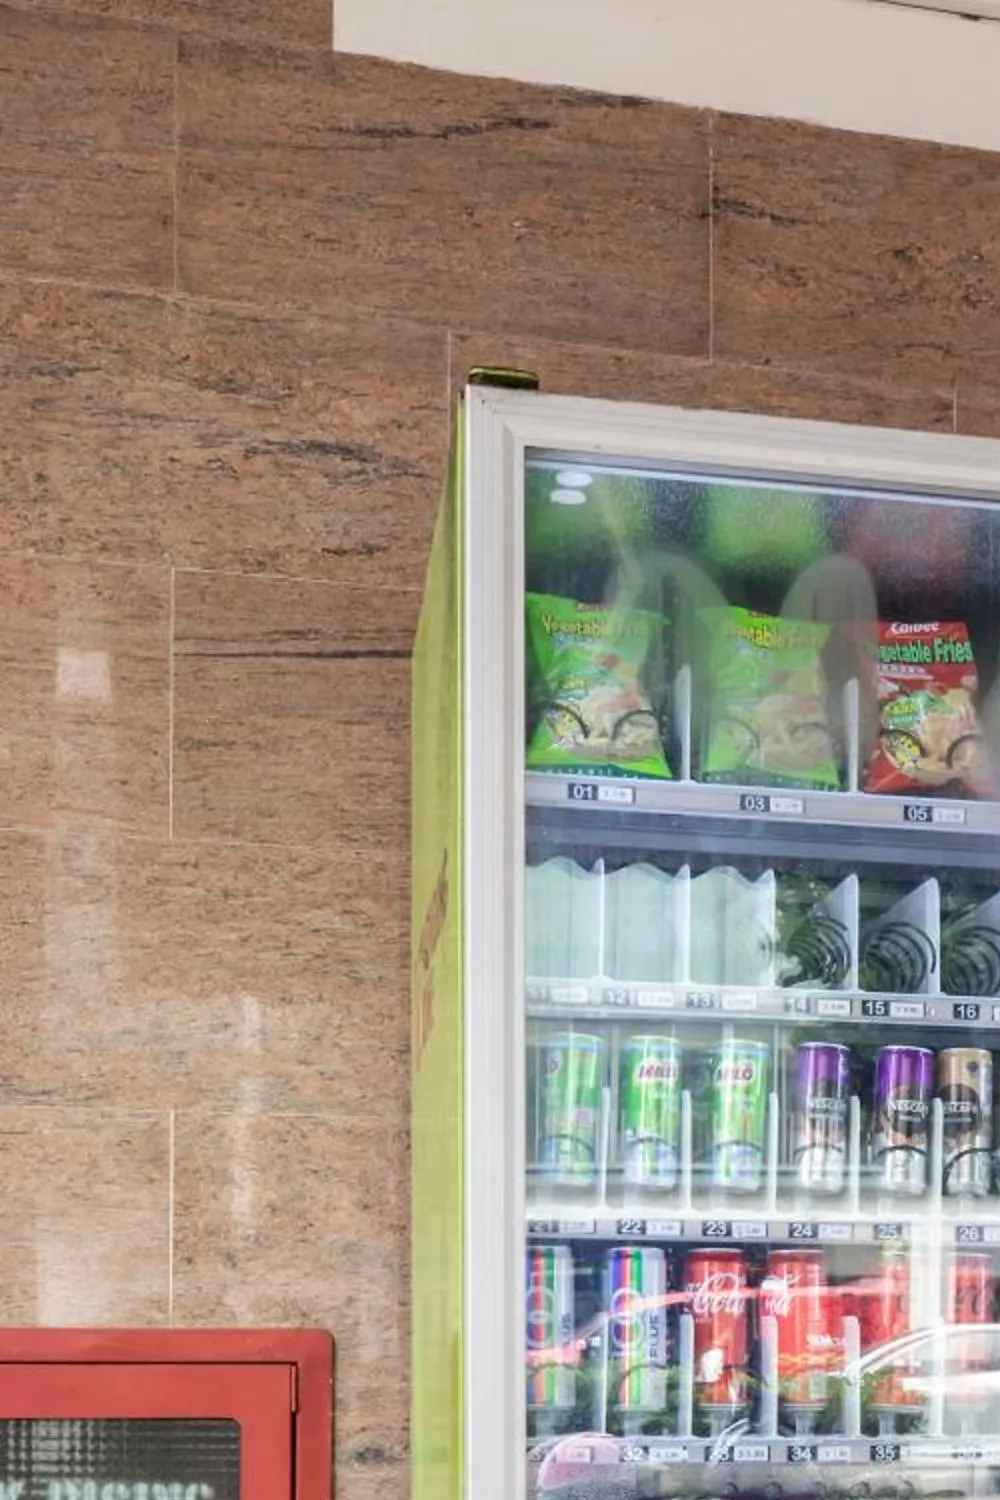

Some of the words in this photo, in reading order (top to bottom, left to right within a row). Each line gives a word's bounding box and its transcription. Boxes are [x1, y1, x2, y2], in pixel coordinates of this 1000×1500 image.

[933, 637, 972, 663] Fries
[573, 785, 593, 799] 01
[745, 795, 765, 812] 03
[908, 806, 928, 821] 05
[866, 1000, 885, 1015] 15
[957, 1003, 977, 1019] 16
[621, 1219, 642, 1234] 22
[707, 1220, 727, 1236] 23
[792, 1222, 812, 1238] 24
[878, 1224, 897, 1239] 25
[959, 1226, 979, 1242] 26
[623, 1445, 643, 1461] 32
[792, 1445, 811, 1461] 34
[876, 1444, 896, 1461] 35
